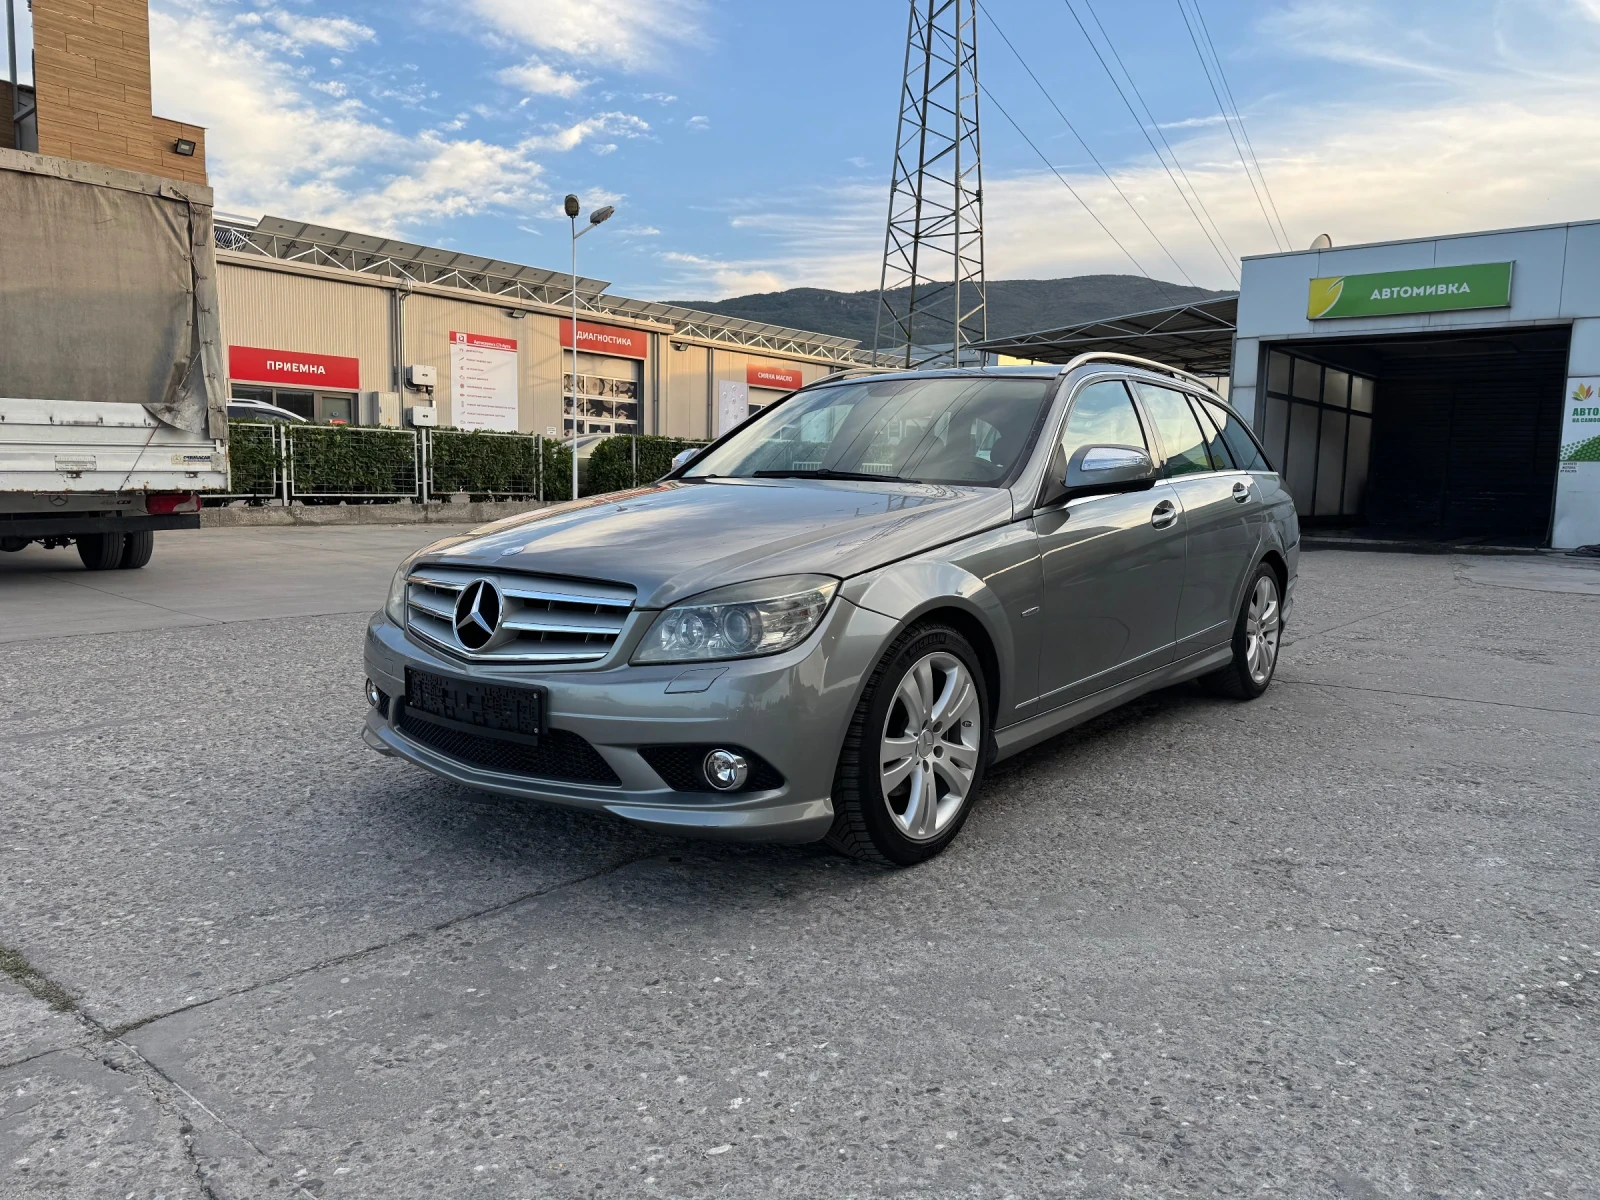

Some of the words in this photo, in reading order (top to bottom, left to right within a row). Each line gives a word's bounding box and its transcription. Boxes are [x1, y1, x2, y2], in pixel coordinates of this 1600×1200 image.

[1370, 282, 1471, 301] АВТОМИВКА
[576, 330, 632, 346] ДИАГНОСТИКА
[266, 360, 326, 375] ПРИЕМНА
[775, 374, 793, 382] МАСЛО
[1572, 407, 1600, 416] АВТО
[909, 633, 946, 654] MICHELIN
